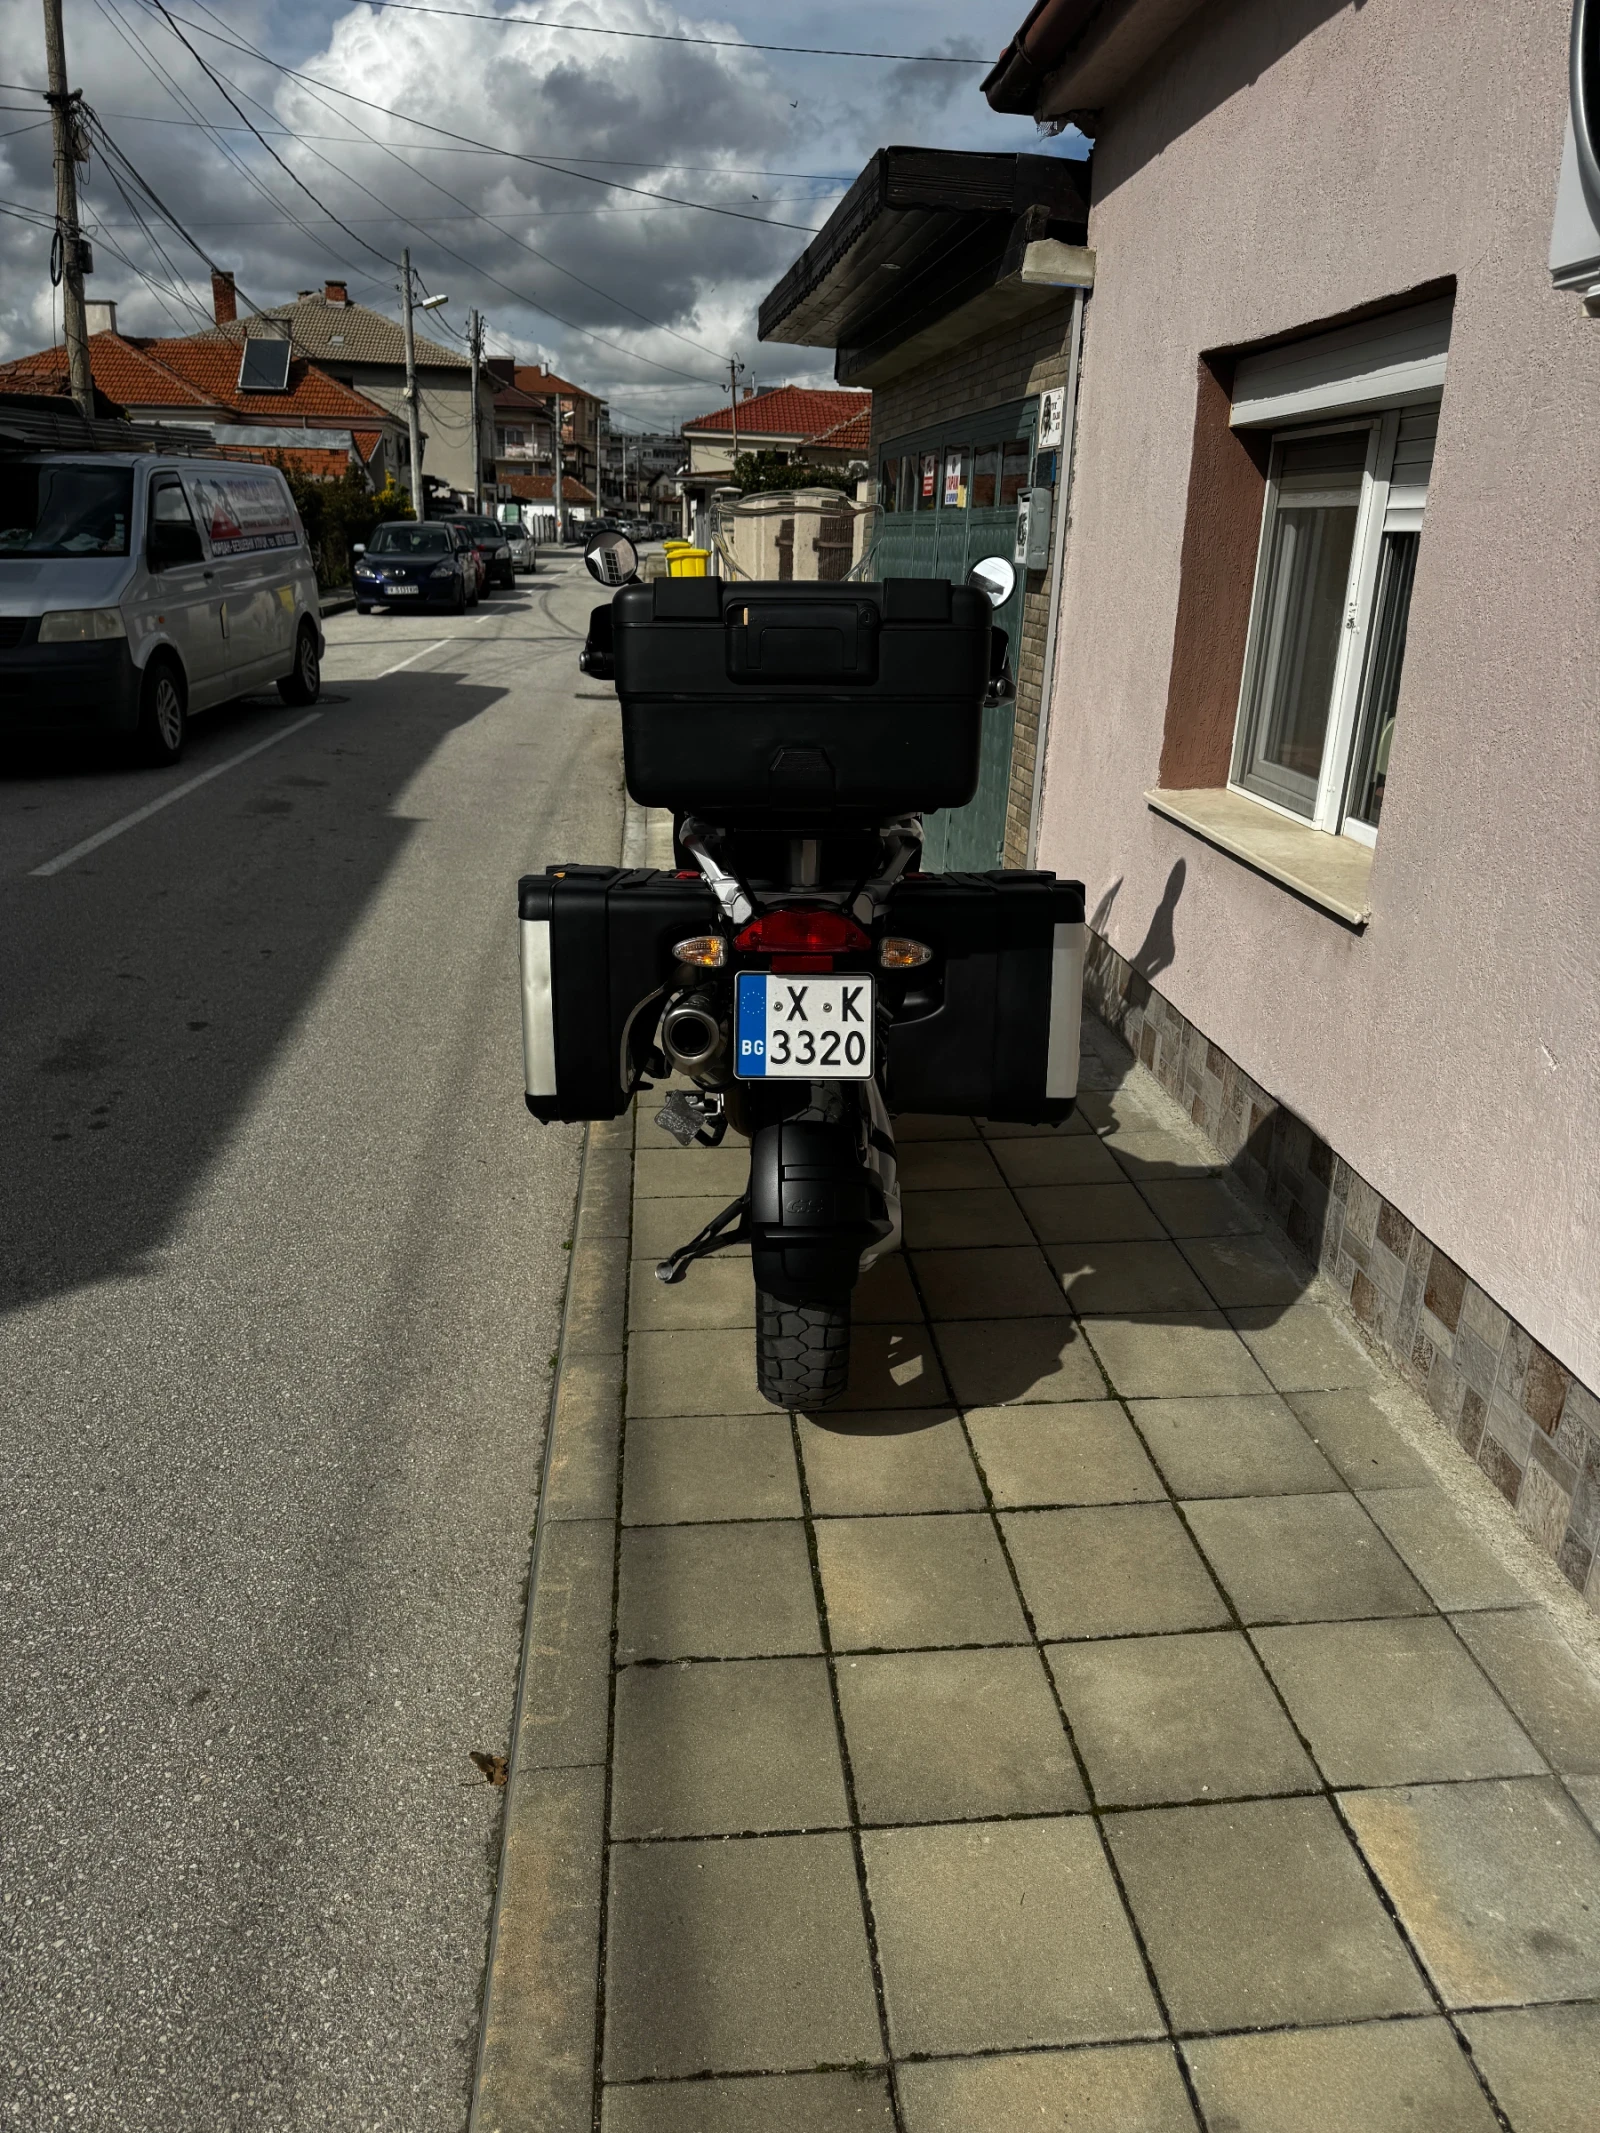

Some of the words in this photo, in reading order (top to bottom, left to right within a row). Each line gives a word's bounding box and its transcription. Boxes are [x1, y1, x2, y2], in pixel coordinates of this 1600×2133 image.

[786, 986, 809, 1021] X
[841, 986, 864, 1022] K
[742, 1040, 764, 1055] BG
[770, 1030, 866, 1066] 3320
